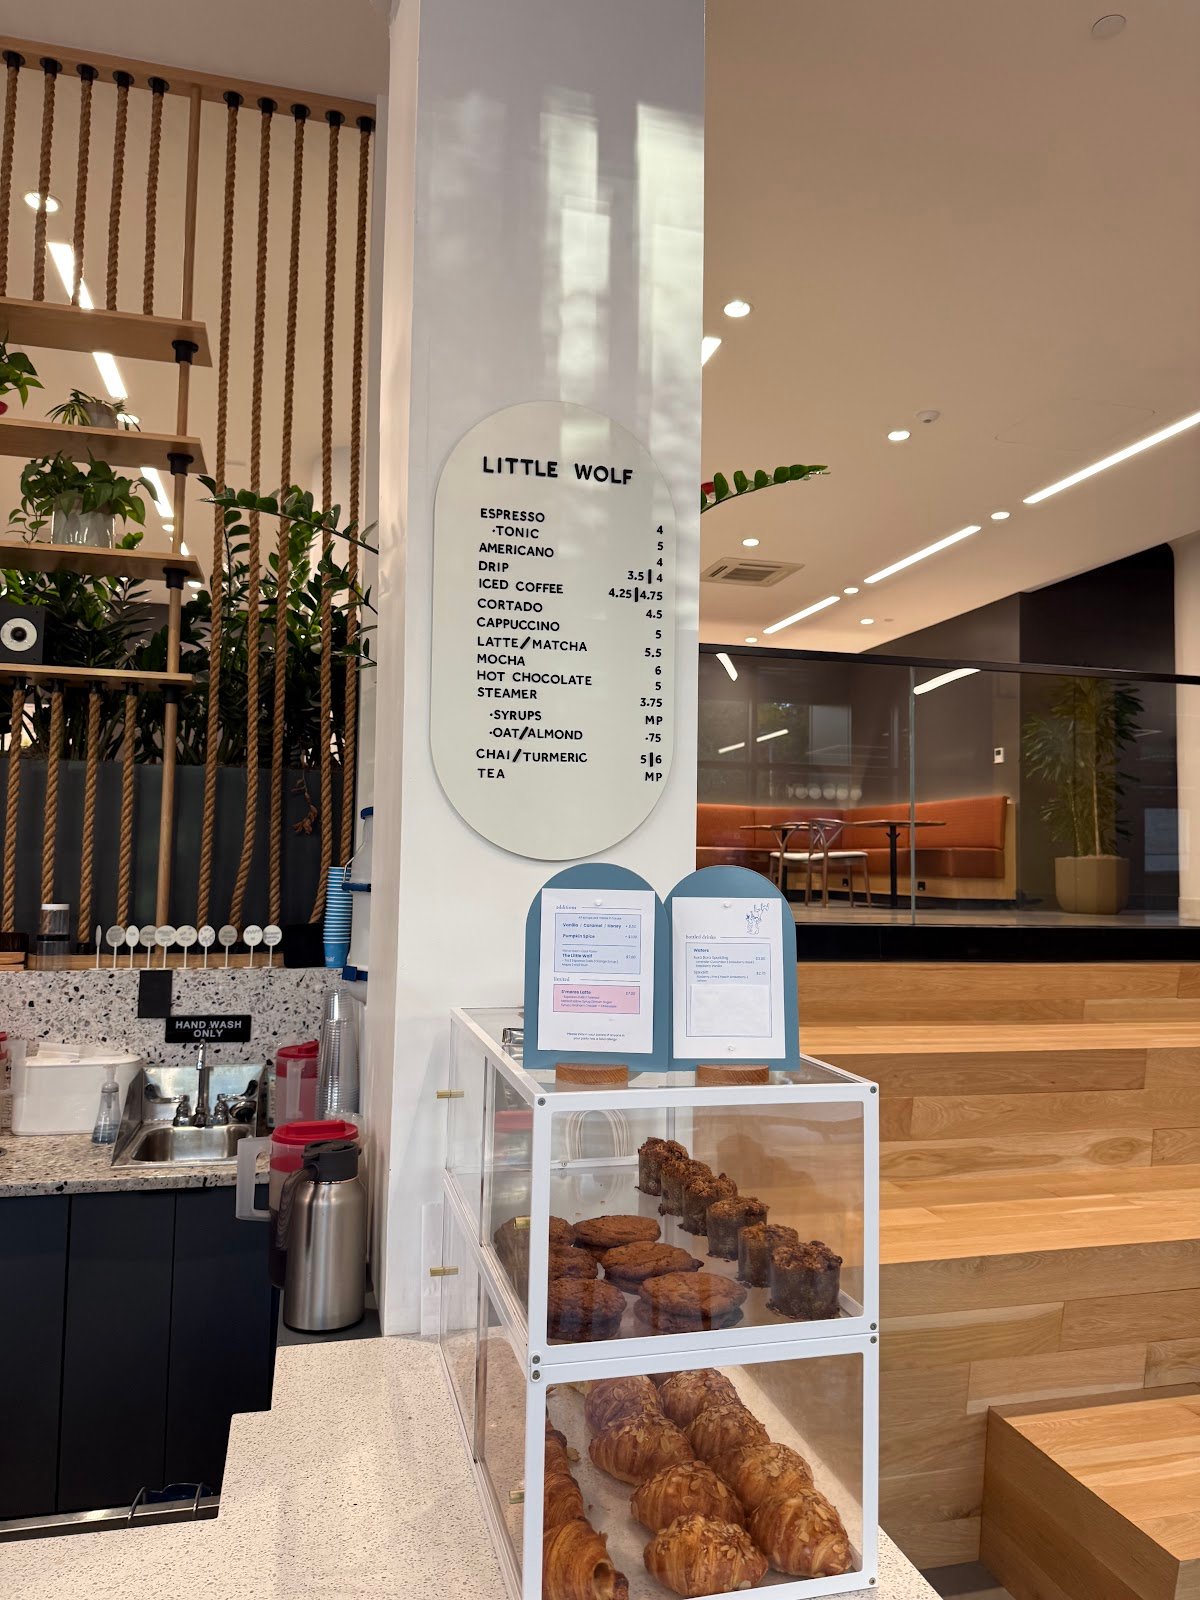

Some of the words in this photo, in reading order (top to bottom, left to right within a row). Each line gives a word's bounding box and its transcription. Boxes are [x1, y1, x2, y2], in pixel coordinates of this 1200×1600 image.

[483, 456, 558, 478] LITTLE
[575, 463, 633, 484] WOLF
[480, 508, 545, 522] ESPRESSO
[656, 525, 663, 534] 4
[479, 543, 554, 558] AMERICANO
[656, 558, 663, 567] 4
[657, 542, 663, 550] 5
[479, 561, 509, 572] DRIP
[479, 578, 509, 590] ICED
[516, 582, 564, 594] COFFEE
[477, 598, 543, 612] CORTADO
[646, 610, 663, 619] 4.5
[477, 617, 560, 631] CAPPUCCINO
[655, 630, 661, 639] 5
[477, 636, 587, 651] LATTE/MATCHA
[645, 648, 662, 657] 5.5
[477, 654, 525, 666] MOCHA
[655, 666, 661, 675] 6
[477, 670, 505, 681] HOT
[512, 672, 592, 685] CHOCOLATE
[655, 682, 661, 690] 5
[477, 687, 537, 699] STEAMER
[640, 698, 663, 707] 3.75
[645, 716, 663, 725] MP
[477, 768, 505, 778] TEA
[645, 772, 663, 781] MP
[175, 1021, 206, 1029] HAND
[193, 1029, 223, 1037] ONLY
